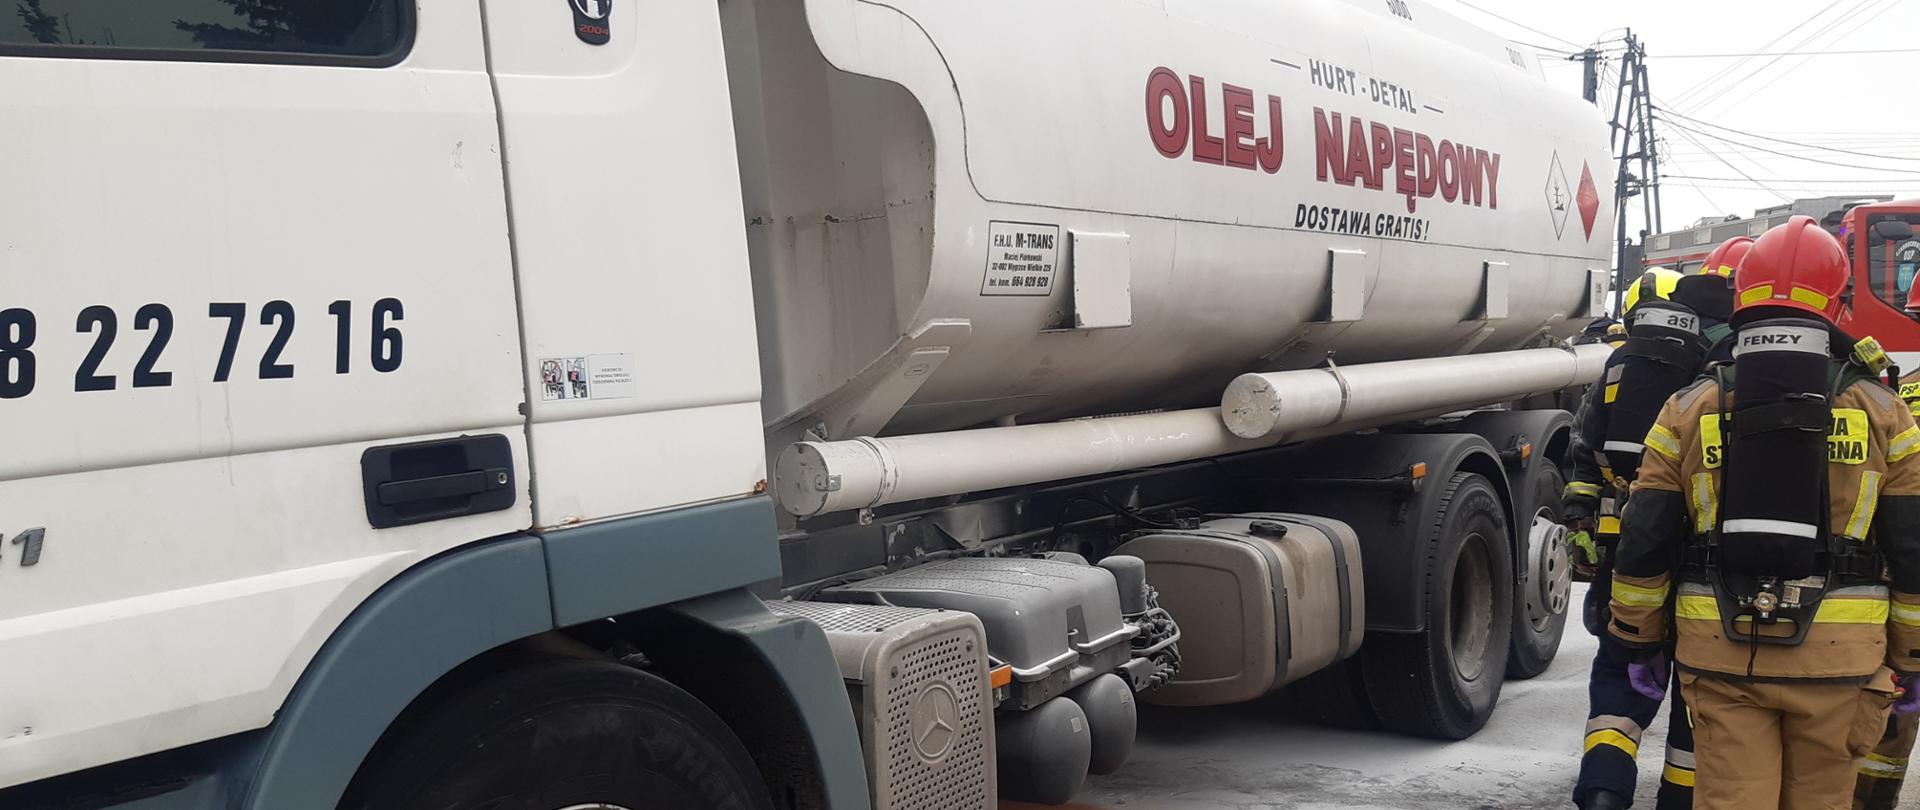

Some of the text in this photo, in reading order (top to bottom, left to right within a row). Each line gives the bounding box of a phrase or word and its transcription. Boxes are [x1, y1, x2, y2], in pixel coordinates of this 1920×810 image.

[1309, 58, 1356, 96] HURT
[1370, 77, 1417, 114] DETAL
[1145, 66, 1501, 213] OLEJ NAPĘDOWY
[1295, 203, 1371, 235] DOSTAWA
[994, 233, 1053, 249] F.H.U. M-TRANS
[1903, 250, 1915, 261] OSP
[1667, 314, 1697, 330] asf
[0, 297, 404, 399] 8 22 72 16
[1743, 334, 1802, 347] FENZY
[1900, 383, 1920, 397] PSP
[1827, 440, 1864, 460] RNA
[0, 527, 46, 567] 1
